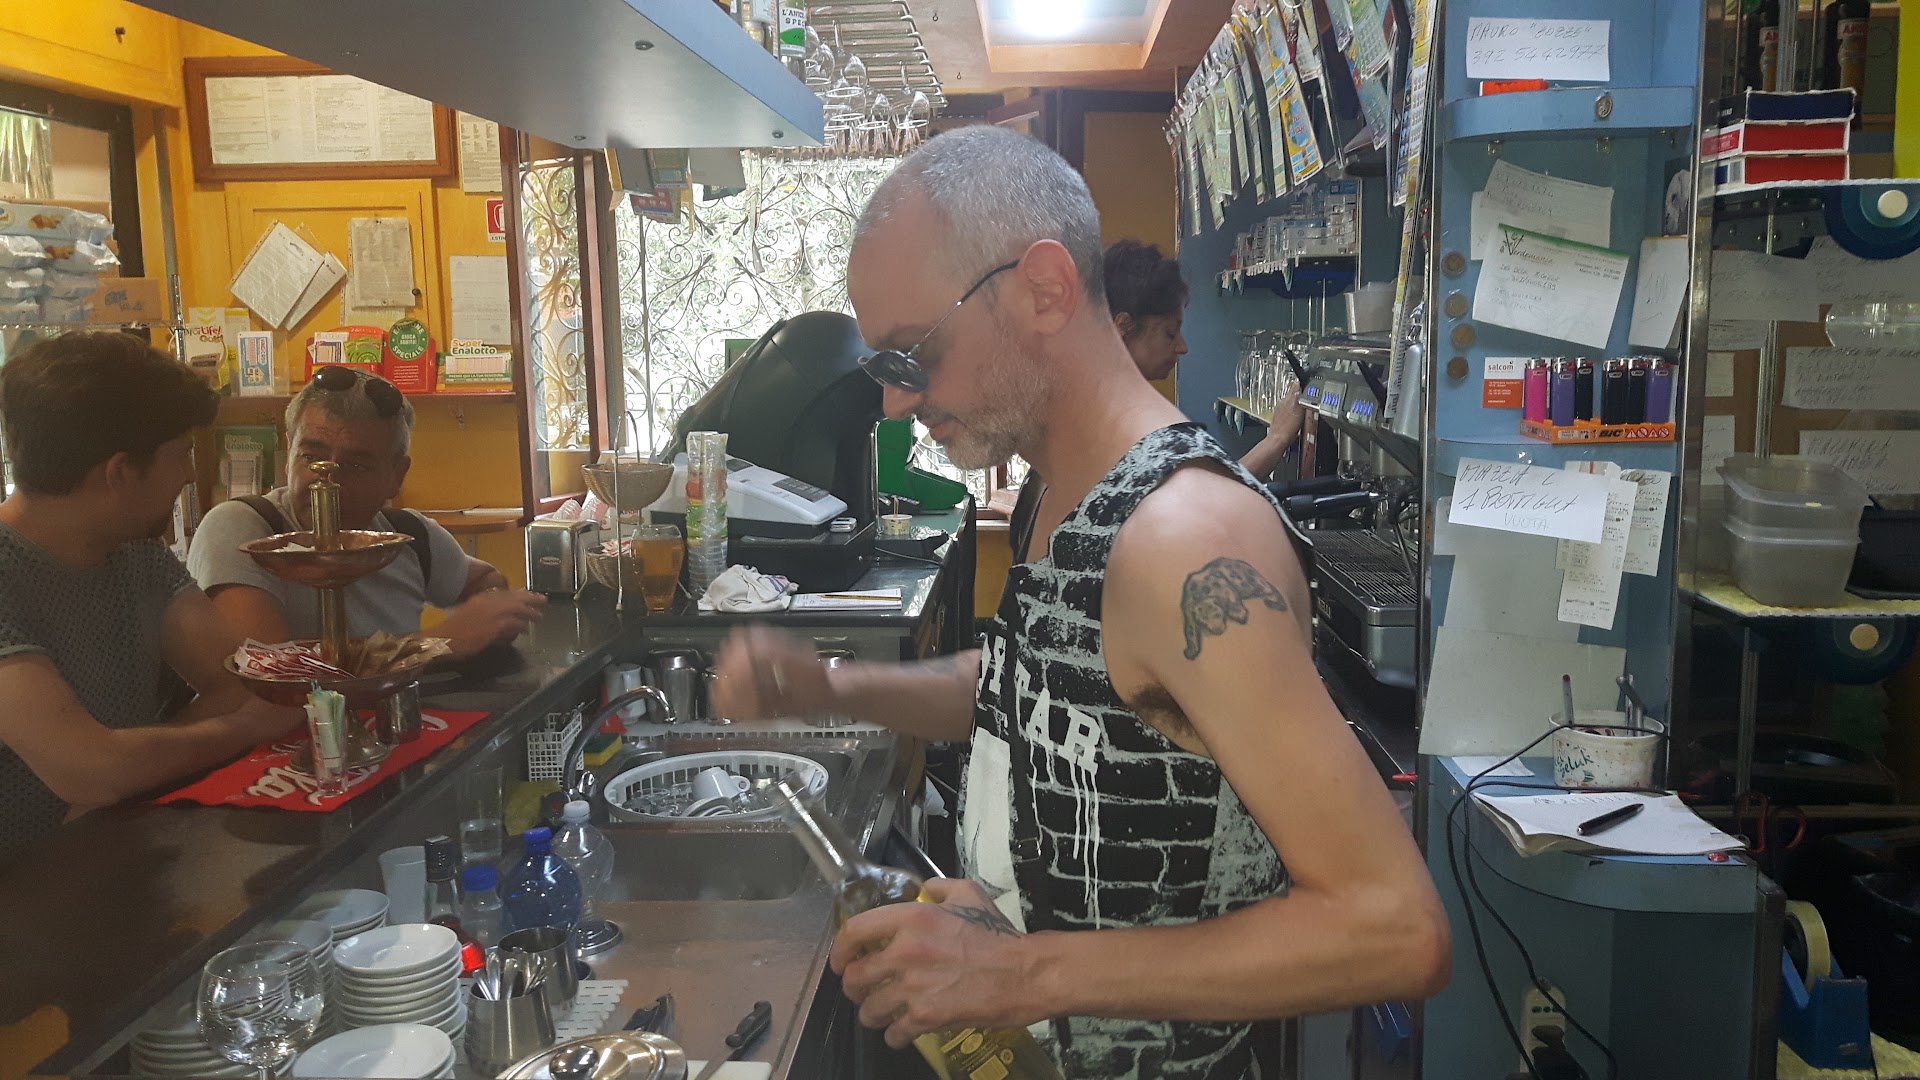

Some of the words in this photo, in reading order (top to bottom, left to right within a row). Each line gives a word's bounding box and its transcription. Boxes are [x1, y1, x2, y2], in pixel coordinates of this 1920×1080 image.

[1471, 22, 1520, 41] MAURO
[452, 339, 482, 347] Super
[392, 345, 425, 359] SPECIALE
[452, 346, 496, 355] Enalotto
[1488, 363, 1514, 371] salcom
[1599, 429, 1624, 438] BIC
[1504, 512, 1549, 530] VUOTA
